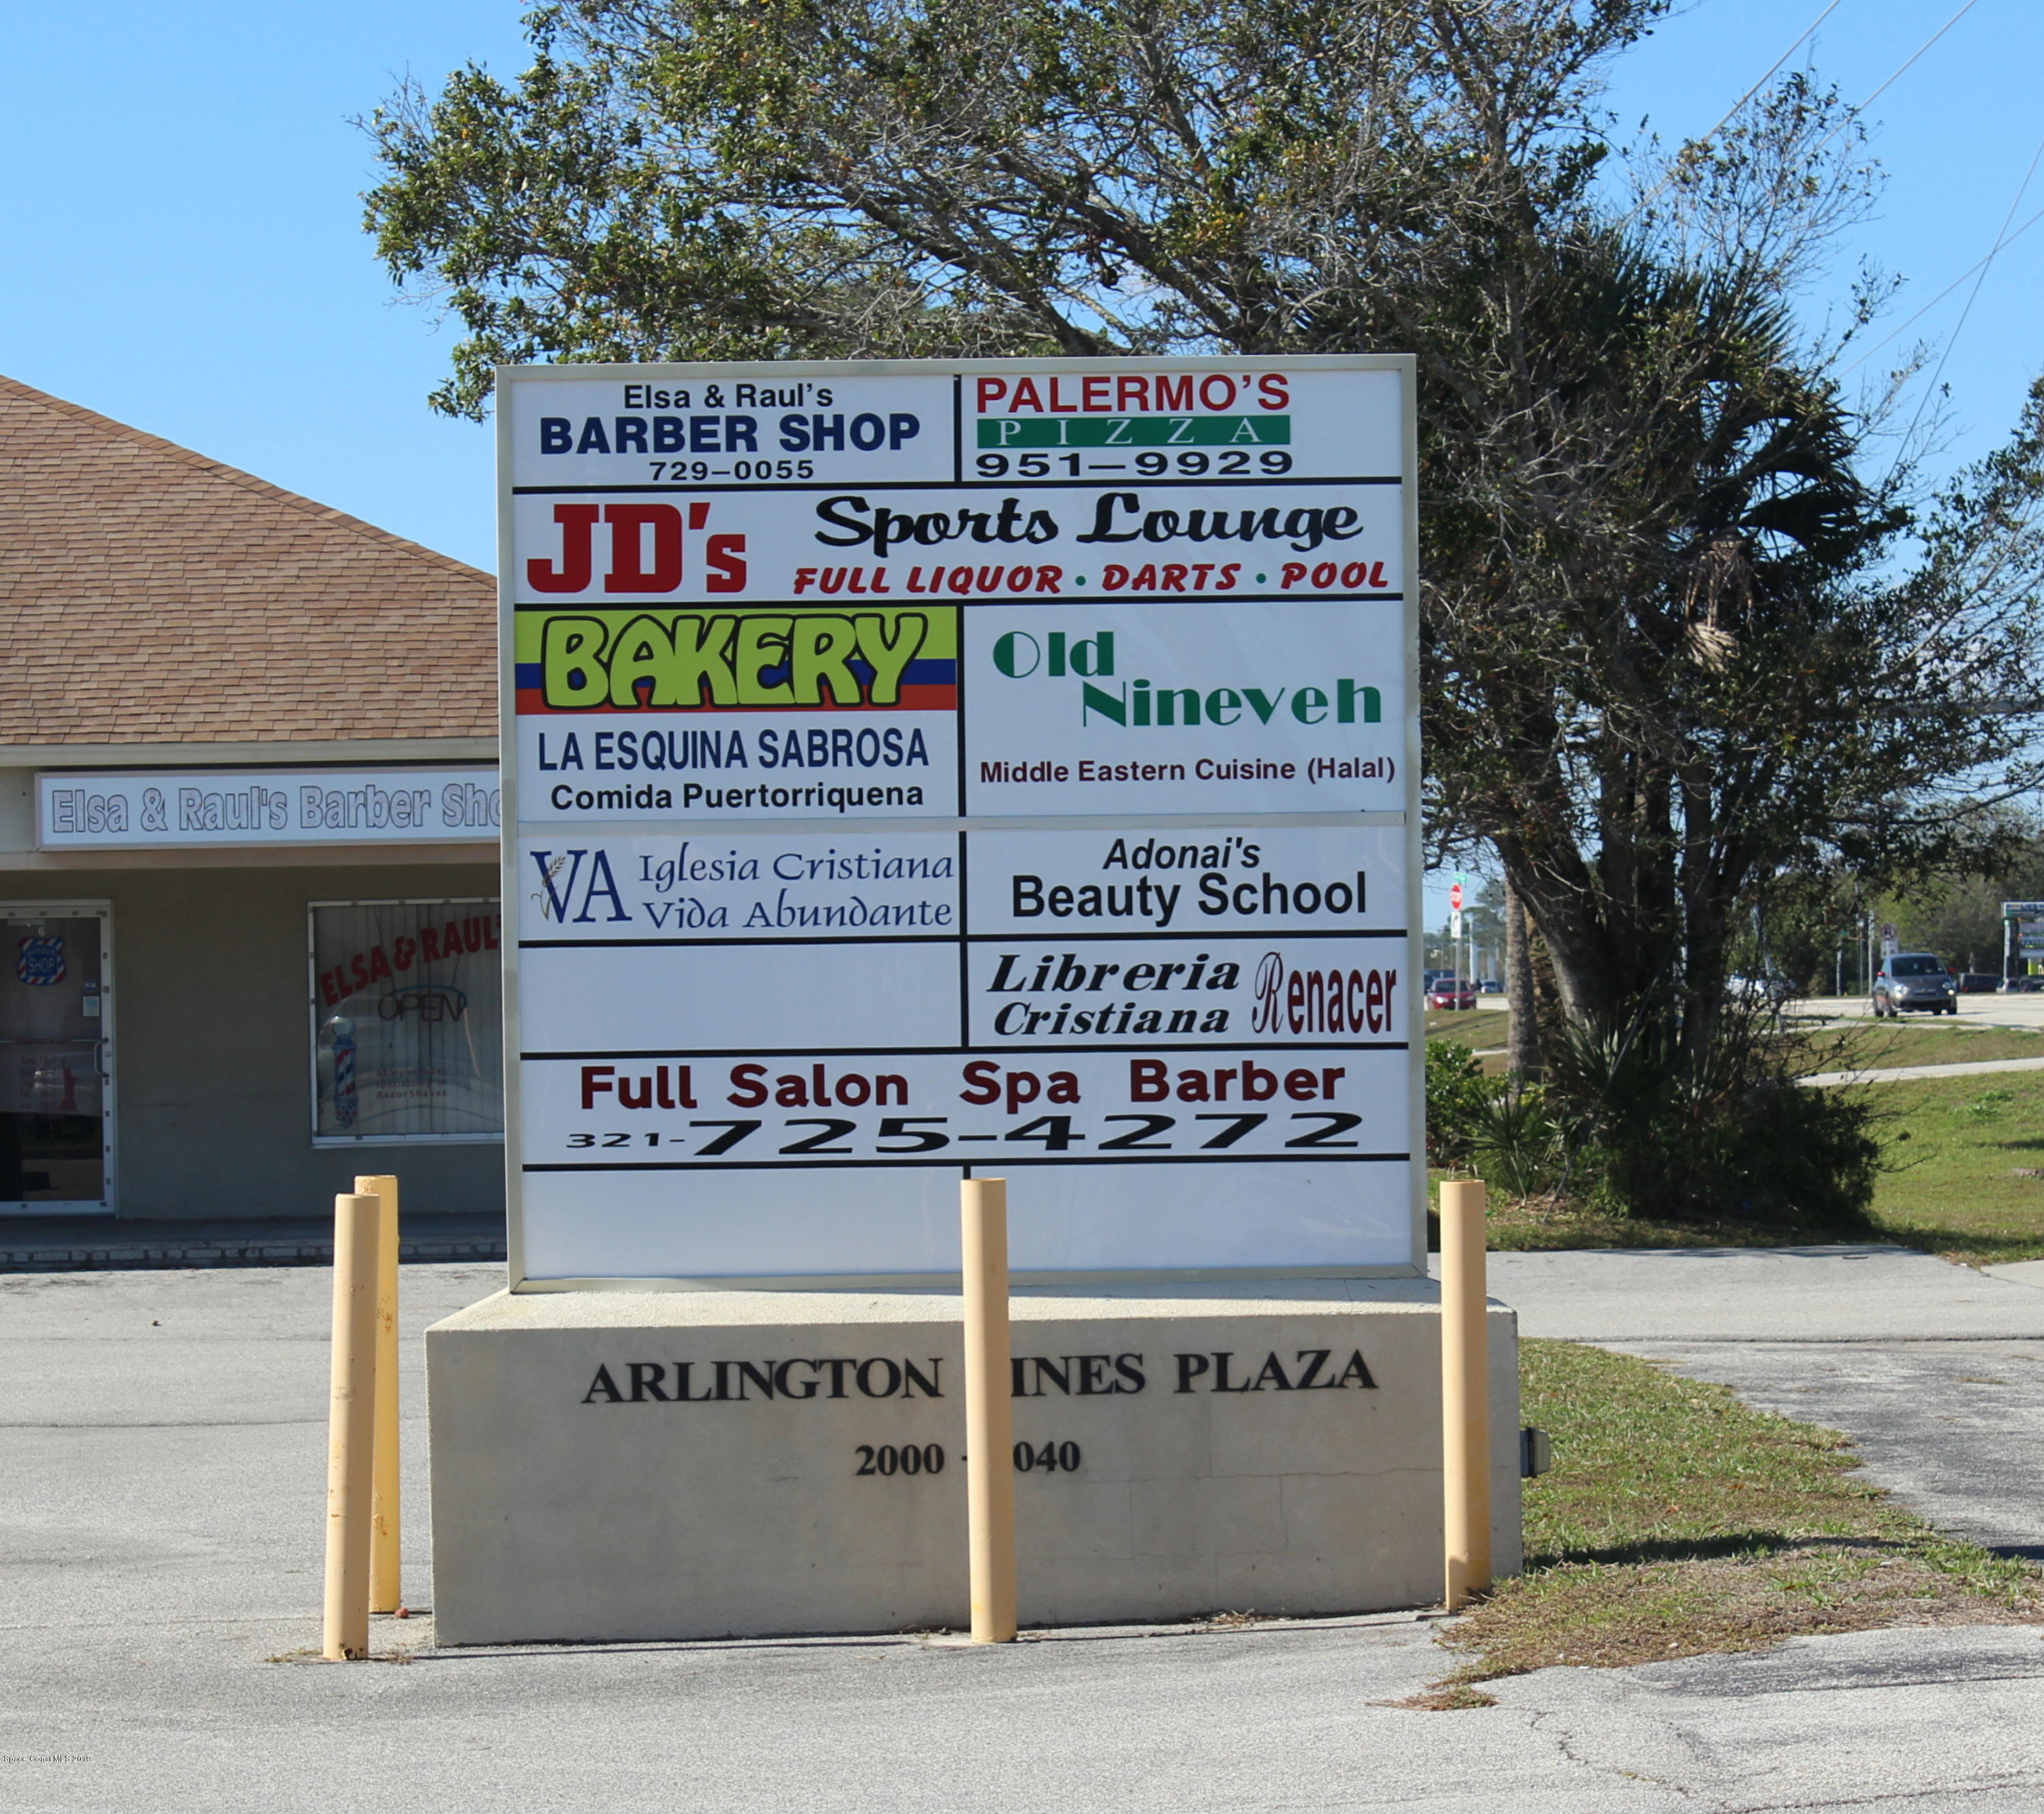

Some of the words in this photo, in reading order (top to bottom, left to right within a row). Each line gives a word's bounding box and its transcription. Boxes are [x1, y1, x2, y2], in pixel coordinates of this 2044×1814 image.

[624, 385, 691, 409] Elsa
[704, 385, 724, 407] &
[736, 383, 833, 407] Raul's
[976, 373, 1290, 413] PALERMO'S
[540, 414, 758, 455] BARBER
[779, 413, 920, 452] SHOP
[996, 417, 1261, 446] PIZZA
[649, 460, 814, 481] 729-0055
[975, 450, 1292, 478] 951-9929
[814, 495, 1059, 558] Sports
[1076, 492, 1363, 552] Lounge
[527, 502, 747, 593] JD's
[793, 566, 890, 595] FULL
[906, 565, 1063, 594] LIQUOR
[1101, 563, 1241, 591] DARTS
[1280, 561, 1389, 589] POOL
[540, 612, 929, 710] BAKERY
[992, 631, 1115, 678] Old
[1082, 678, 1382, 728] Nineveh
[538, 731, 584, 771] LA
[594, 729, 747, 771] ESQUINA
[758, 728, 929, 768] SABROSA
[980, 760, 1068, 783] Middle
[1078, 758, 1186, 782] Eastern
[1194, 757, 1296, 780] Cuisine
[1307, 756, 1395, 784] (Halal)
[52, 789, 129, 834] Elsa
[140, 787, 168, 832] &
[179, 785, 288, 830] Raul's
[300, 783, 431, 828] Barber
[551, 783, 672, 811] Comida
[682, 781, 924, 813] Puertorriquena
[638, 841, 760, 893] Iglesia
[772, 847, 955, 881] Cristiana
[1102, 836, 1260, 870] Adonai's
[529, 848, 632, 924] VA
[1012, 874, 1181, 927] Beauty
[1197, 871, 1366, 916] School
[641, 896, 728, 930] Vida
[741, 888, 953, 928] Abundante
[29, 957, 55, 973] SHOP
[320, 945, 392, 1007] ELSA
[394, 936, 416, 971] &
[986, 953, 1240, 992] Libreria
[378, 992, 462, 1022] OPEN
[1251, 951, 1397, 1035] Renacer
[993, 1001, 1229, 1036] Cristiana
[580, 1065, 698, 1110] Full
[726, 1063, 909, 1108] Salon
[959, 1060, 1081, 1114] Spa
[1130, 1059, 1346, 1102] Barber
[581, 1358, 945, 1405] ARLINGTON
[1010, 1352, 1146, 1397] INES
[1173, 1348, 1379, 1394] PLAZA
[854, 1443, 945, 1477] 2000
[1012, 1441, 1081, 1474] 040
